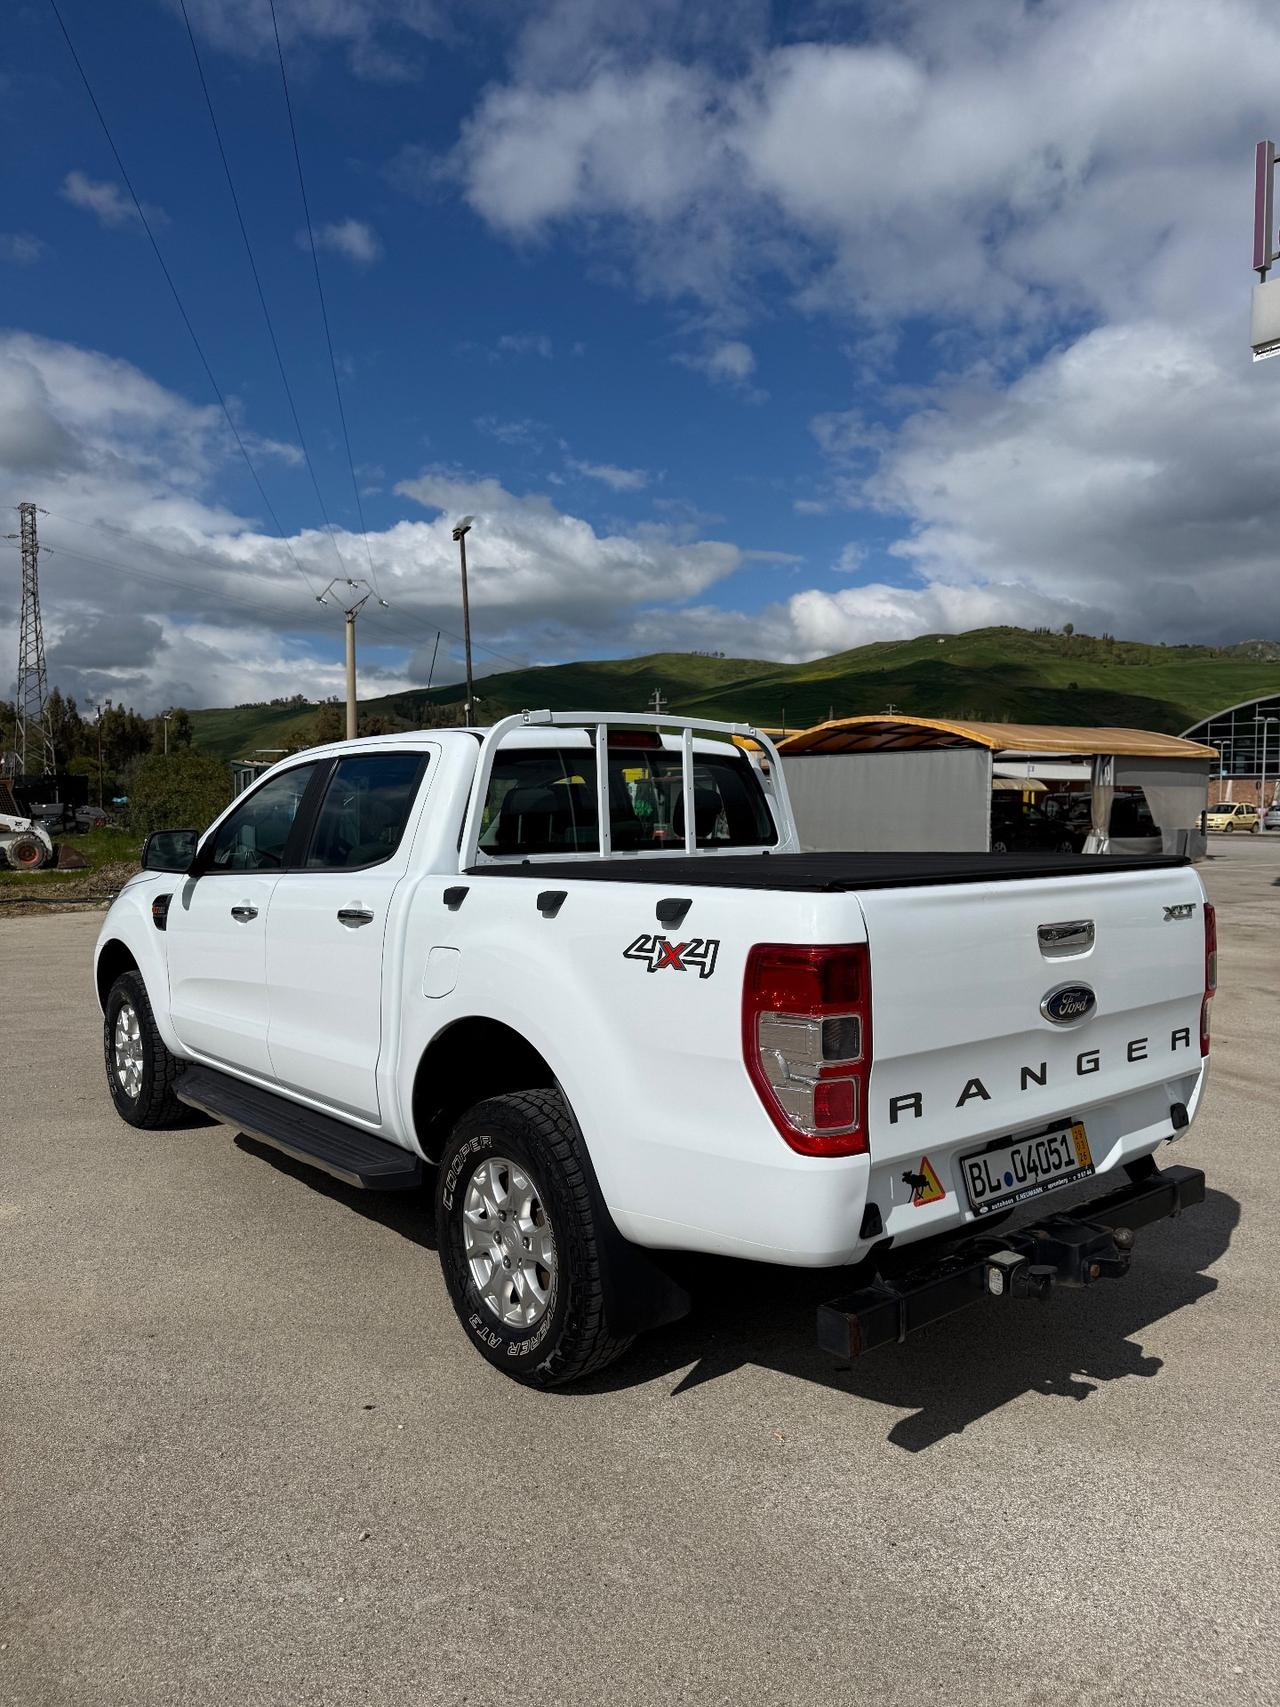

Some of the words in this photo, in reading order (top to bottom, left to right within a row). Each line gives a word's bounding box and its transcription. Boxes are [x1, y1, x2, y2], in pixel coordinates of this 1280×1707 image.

[1162, 903, 1196, 921] XLT
[1059, 992, 1088, 1015] Ford
[889, 1027, 1191, 1125] RANGER
[443, 1135, 493, 1210] COOPER
[968, 1159, 1001, 1198] BL
[1010, 1134, 1076, 1183] 04051
[469, 1313, 502, 1349] AT3
